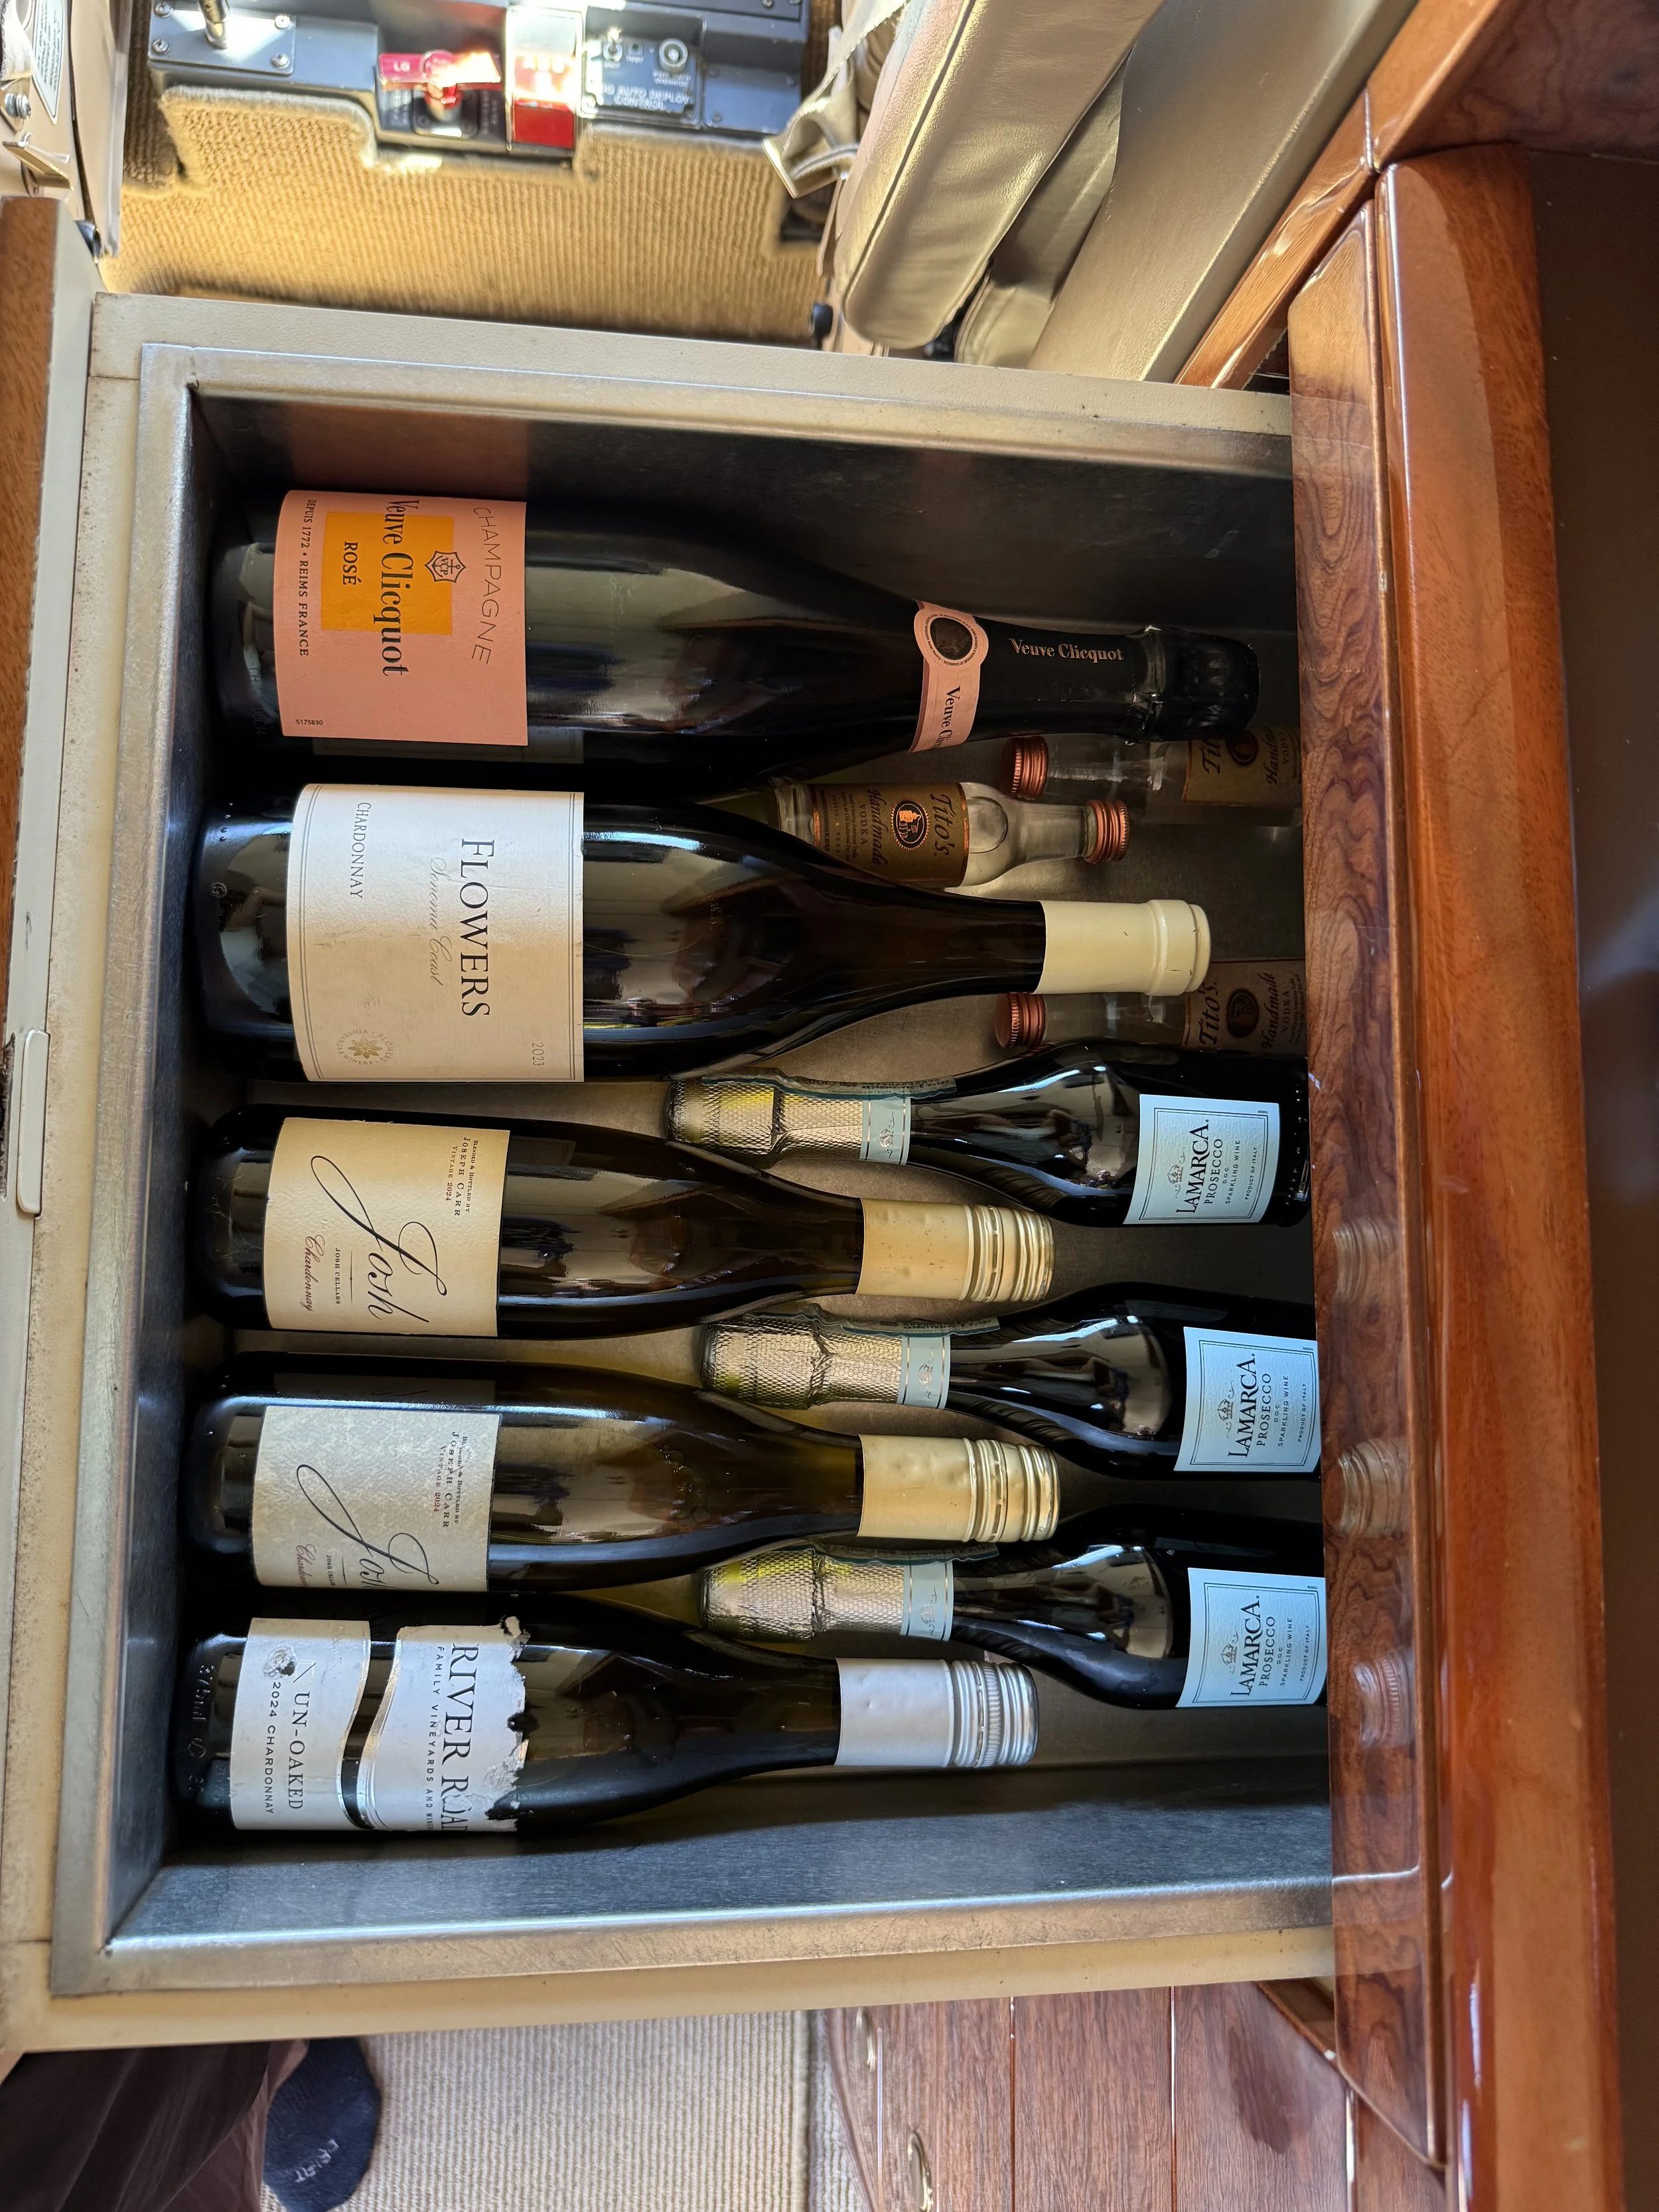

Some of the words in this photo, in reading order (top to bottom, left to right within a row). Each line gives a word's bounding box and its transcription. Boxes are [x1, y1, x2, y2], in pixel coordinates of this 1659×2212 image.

[303, 499, 317, 523] DEPUIS
[383, 499, 419, 545] Veuve
[301, 527, 311, 548] 1772
[299, 560, 309, 597] REIMS
[342, 541, 362, 585] ROSÉ
[440, 557, 449, 575] VCP
[472, 507, 502, 664] CHAMPAGNE
[299, 603, 309, 656] FRANCE
[374, 552, 414, 676] Clicquot
[1009, 638, 1054, 657] Veuve
[1058, 644, 1123, 663] Clicquot
[942, 685, 960, 728] Veuve
[867, 788, 889, 865] Handmade
[930, 793, 956, 855] Tito's
[350, 802, 371, 899] CHARDONNAY
[429, 856, 451, 930] Sonoma
[460, 838, 494, 1016] FLOWERS
[429, 935, 452, 986] Coast
[531, 1042, 544, 1066] 2023
[447, 1145, 458, 1179] VINTAGE
[457, 1137, 470, 1176] JOSEPH
[469, 1140, 478, 1164] BLENDED
[1204, 1139, 1222, 1204] PROSECCO
[454, 1183, 464, 1217] CARR
[1226, 1163, 1238, 1204] SPARKLING
[1245, 1174, 1254, 1200] PRODUCT
[465, 1203, 470, 1213] BY
[311, 1155, 447, 1323] Josh
[301, 1234, 326, 1311] Chardonnay
[1257, 1374, 1271, 1445] PROSECCO
[1277, 1402, 1288, 1446] SPARKLING
[1302, 1403, 1306, 1412] OF
[436, 1445, 447, 1487] VINTAGE
[446, 1432, 459, 1484] JOSEPH
[443, 1493, 453, 1528] CARR
[432, 1646, 444, 1694] FAMILY
[1260, 1616, 1275, 1686] PROSECCO
[1279, 1641, 1291, 1686] SPARKLING
[269, 1681, 281, 1718] 2024
[442, 1643, 479, 1765] RIVER
[288, 1691, 311, 1809] UN-OAKED
[425, 1704, 438, 1781] VINEYARDS
[264, 1725, 275, 1813] CHARDONNAY
